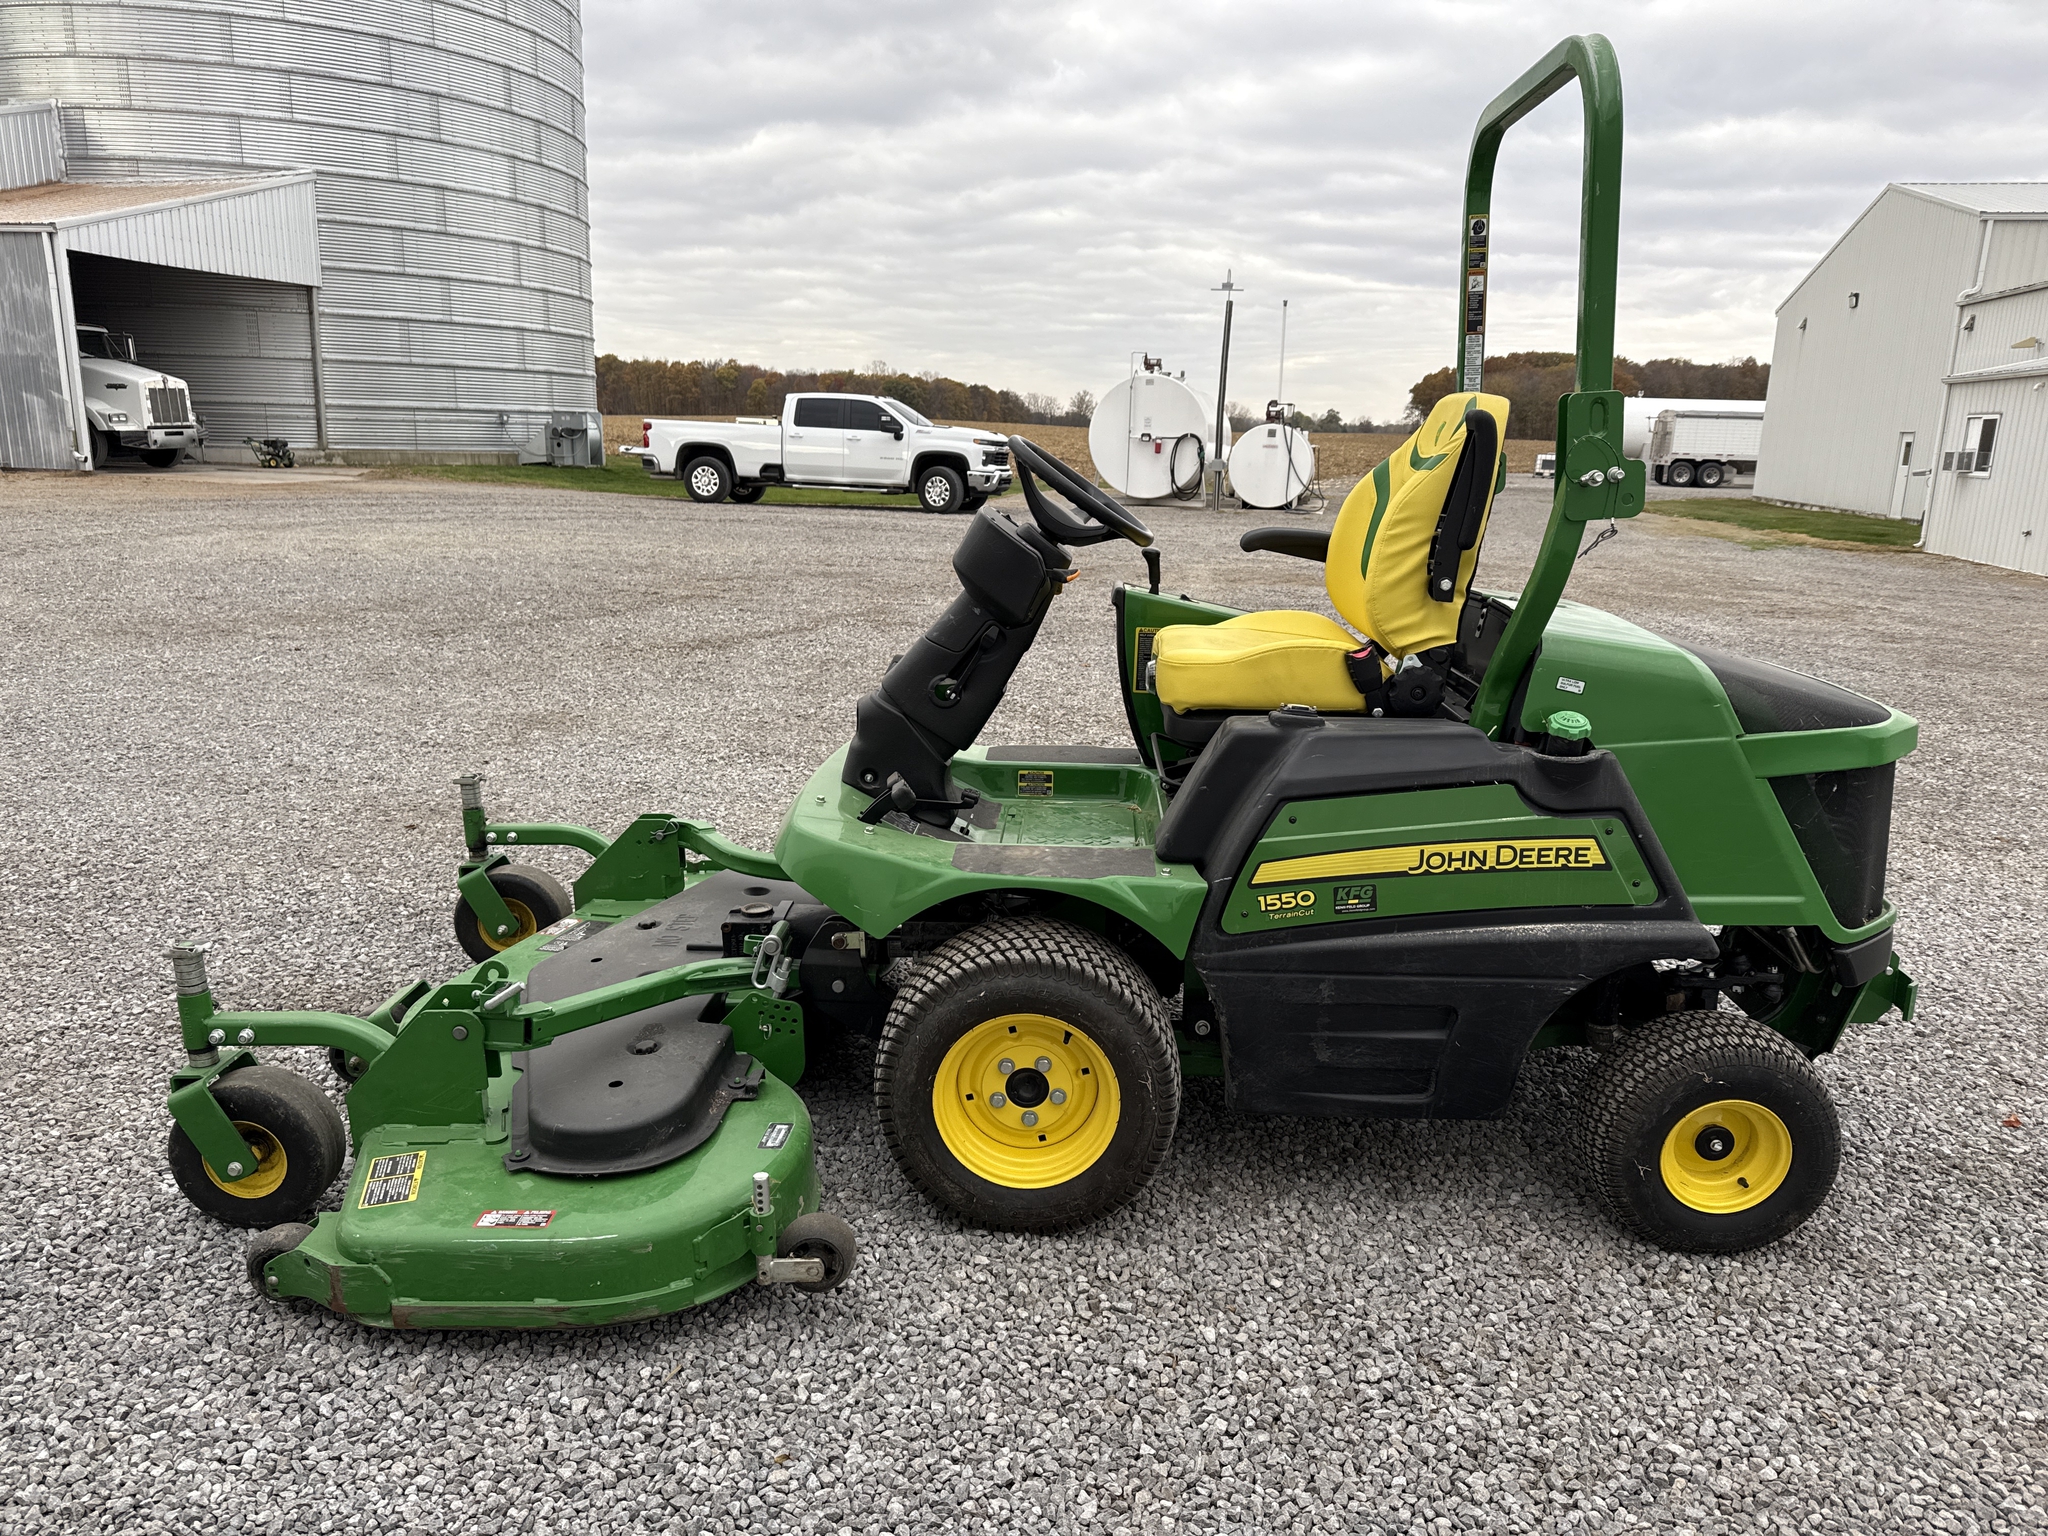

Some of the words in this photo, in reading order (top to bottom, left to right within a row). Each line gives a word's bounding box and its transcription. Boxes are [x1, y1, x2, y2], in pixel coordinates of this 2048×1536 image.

[1408, 848, 1488, 872] JOHN
[1495, 844, 1591, 867] DEERE
[1257, 890, 1316, 911] 1550
[1336, 885, 1373, 900] KFG
[665, 913, 700, 931] STEP
[1268, 909, 1315, 920] TerrainCut
[651, 935, 683, 947] NO
